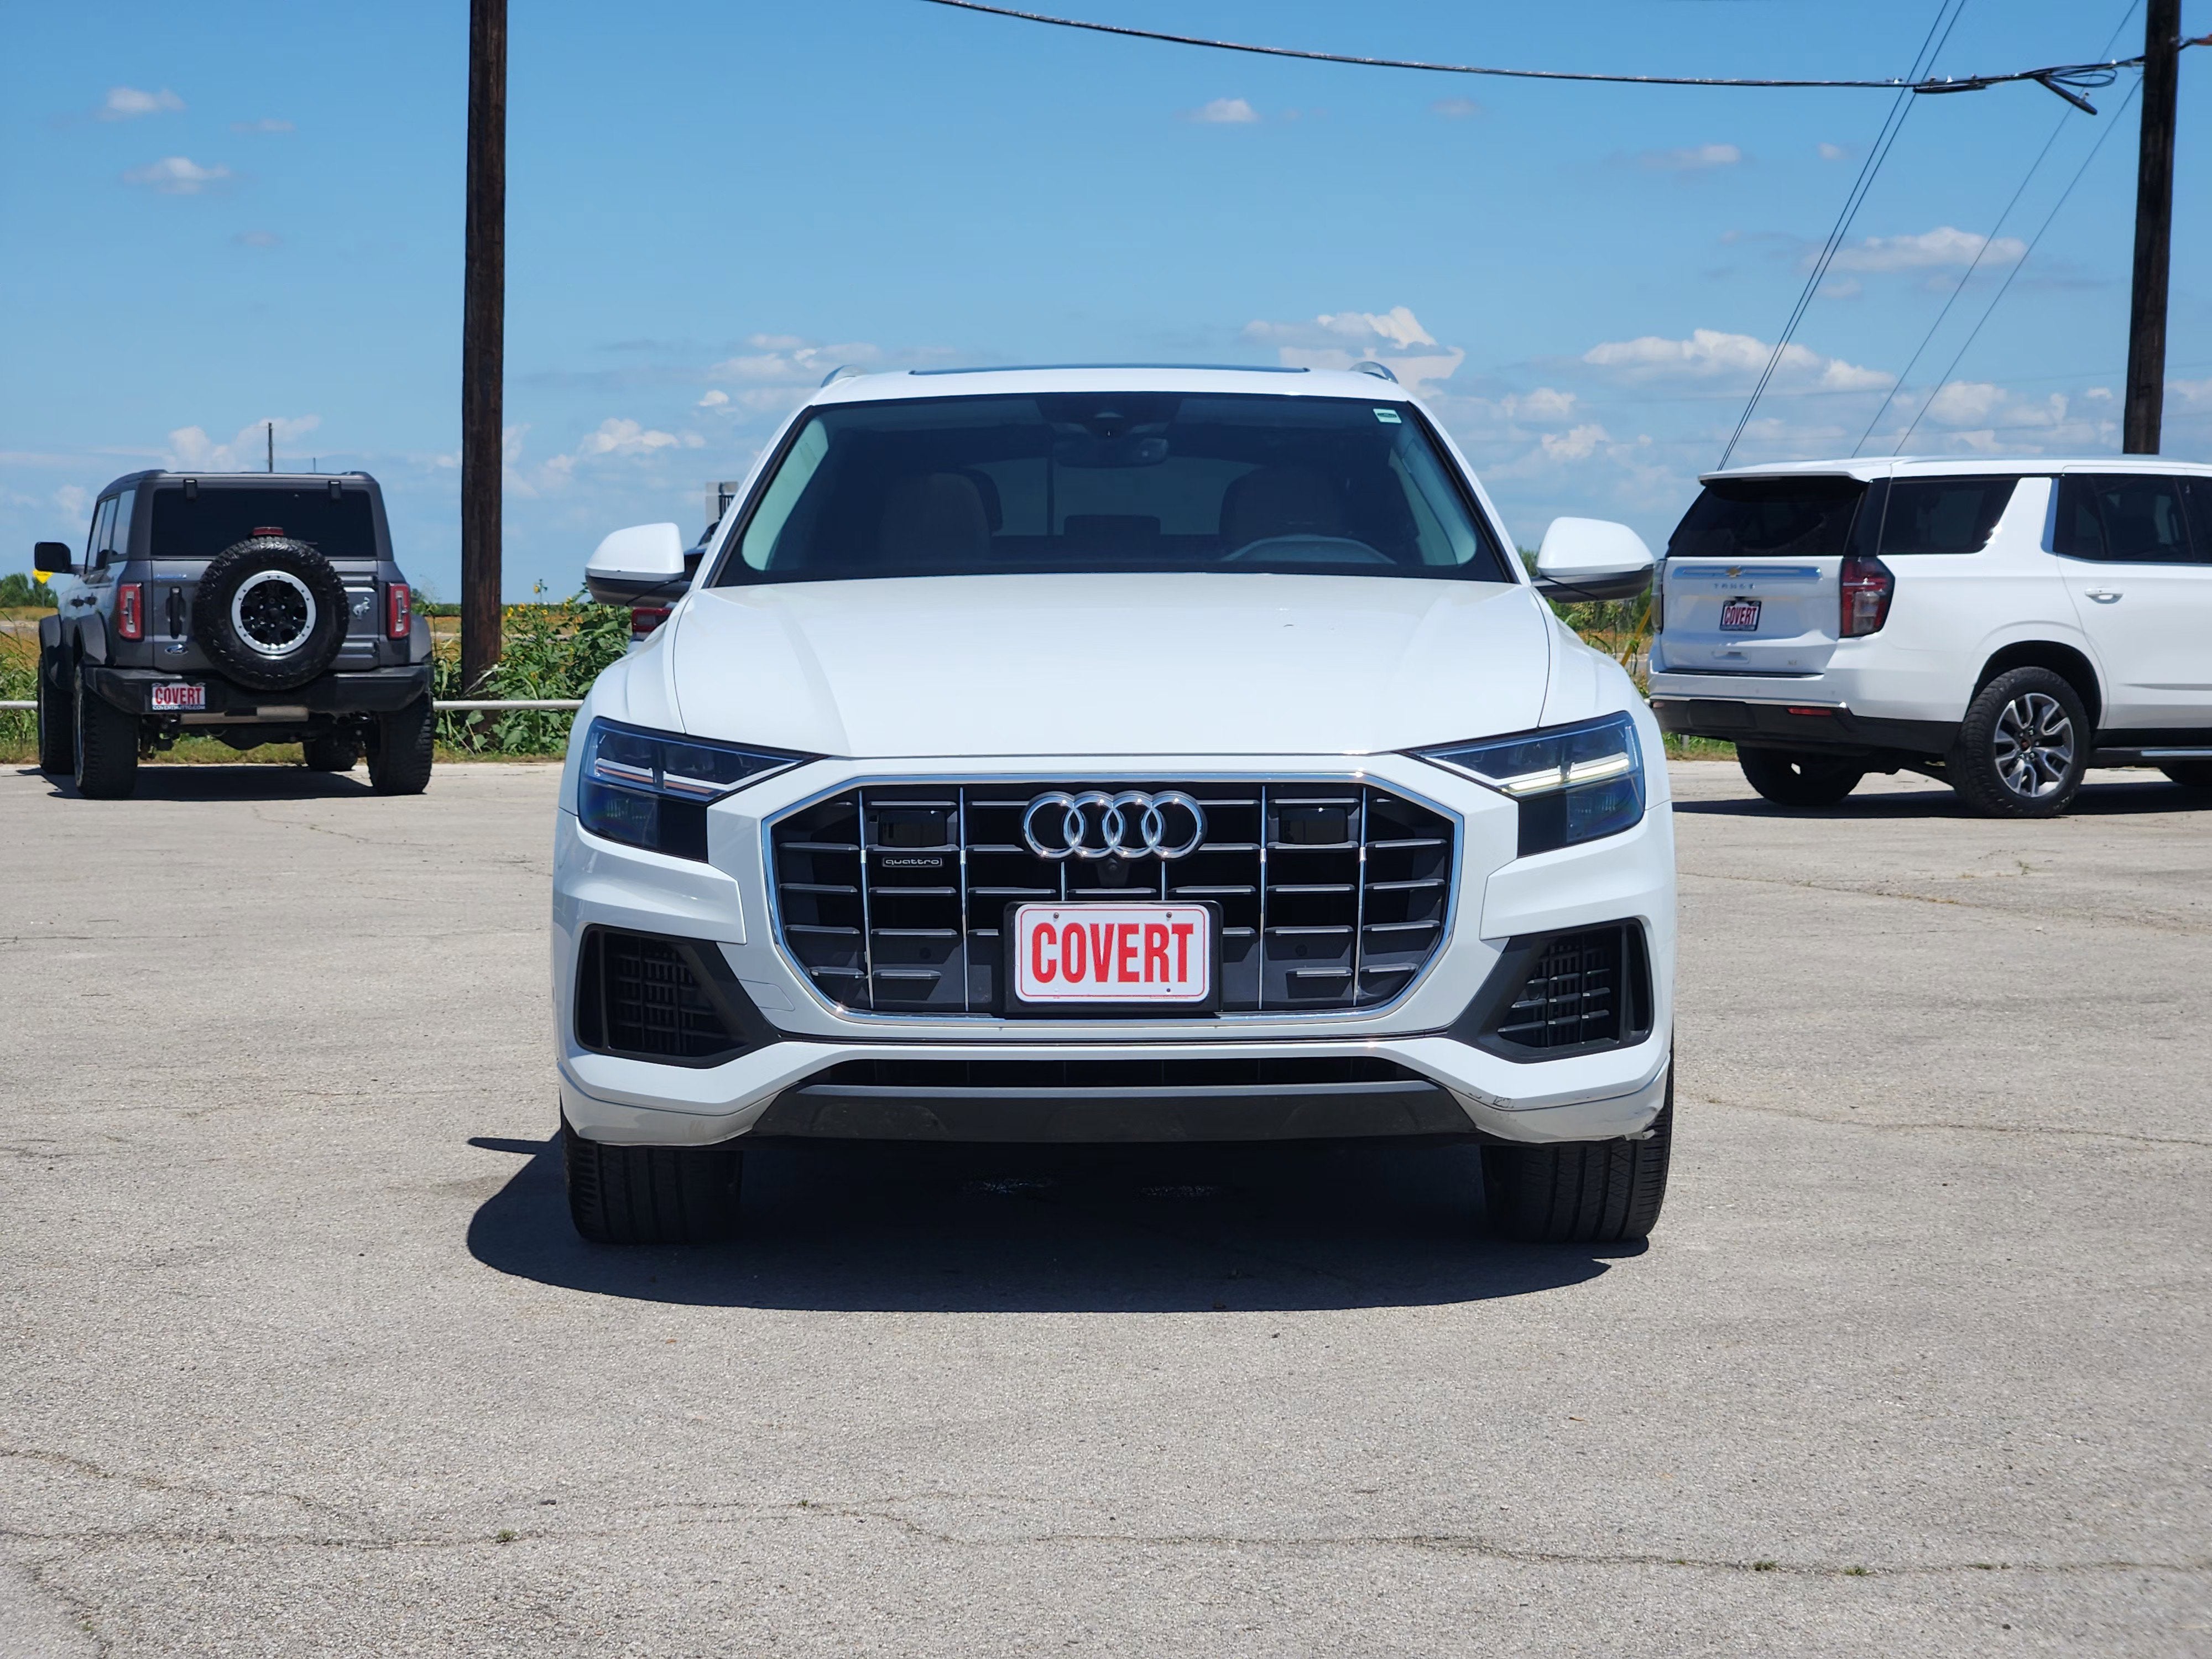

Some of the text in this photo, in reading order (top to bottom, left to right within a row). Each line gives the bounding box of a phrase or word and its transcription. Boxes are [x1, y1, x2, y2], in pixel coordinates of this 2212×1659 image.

[1724, 607, 1757, 625] COVERT
[155, 687, 202, 705] COVERT
[1032, 922, 1193, 983] COVERT
